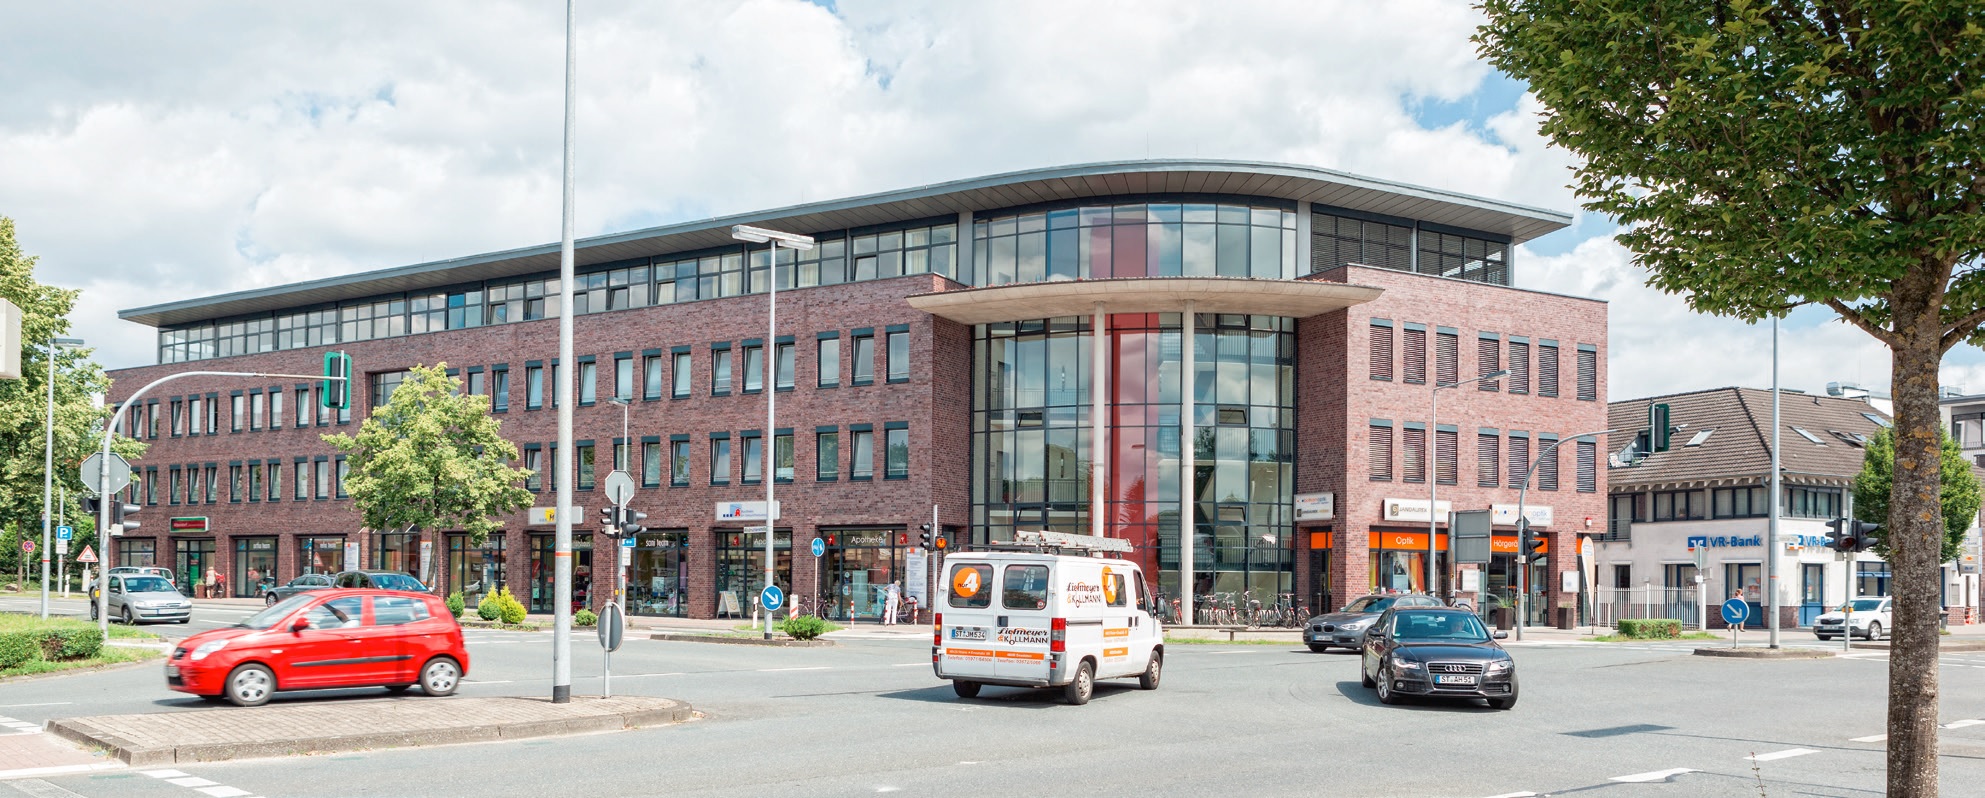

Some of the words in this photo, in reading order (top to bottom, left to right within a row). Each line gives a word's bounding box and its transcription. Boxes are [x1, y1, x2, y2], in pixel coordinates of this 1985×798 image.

[60, 527, 69, 538] P
[753, 538, 783, 546] Apoeke
[851, 535, 883, 544] Apotheke
[1395, 536, 1414, 546] Optik
[1709, 534, 1761, 547] VR-Bank
[963, 572, 979, 593] 4
